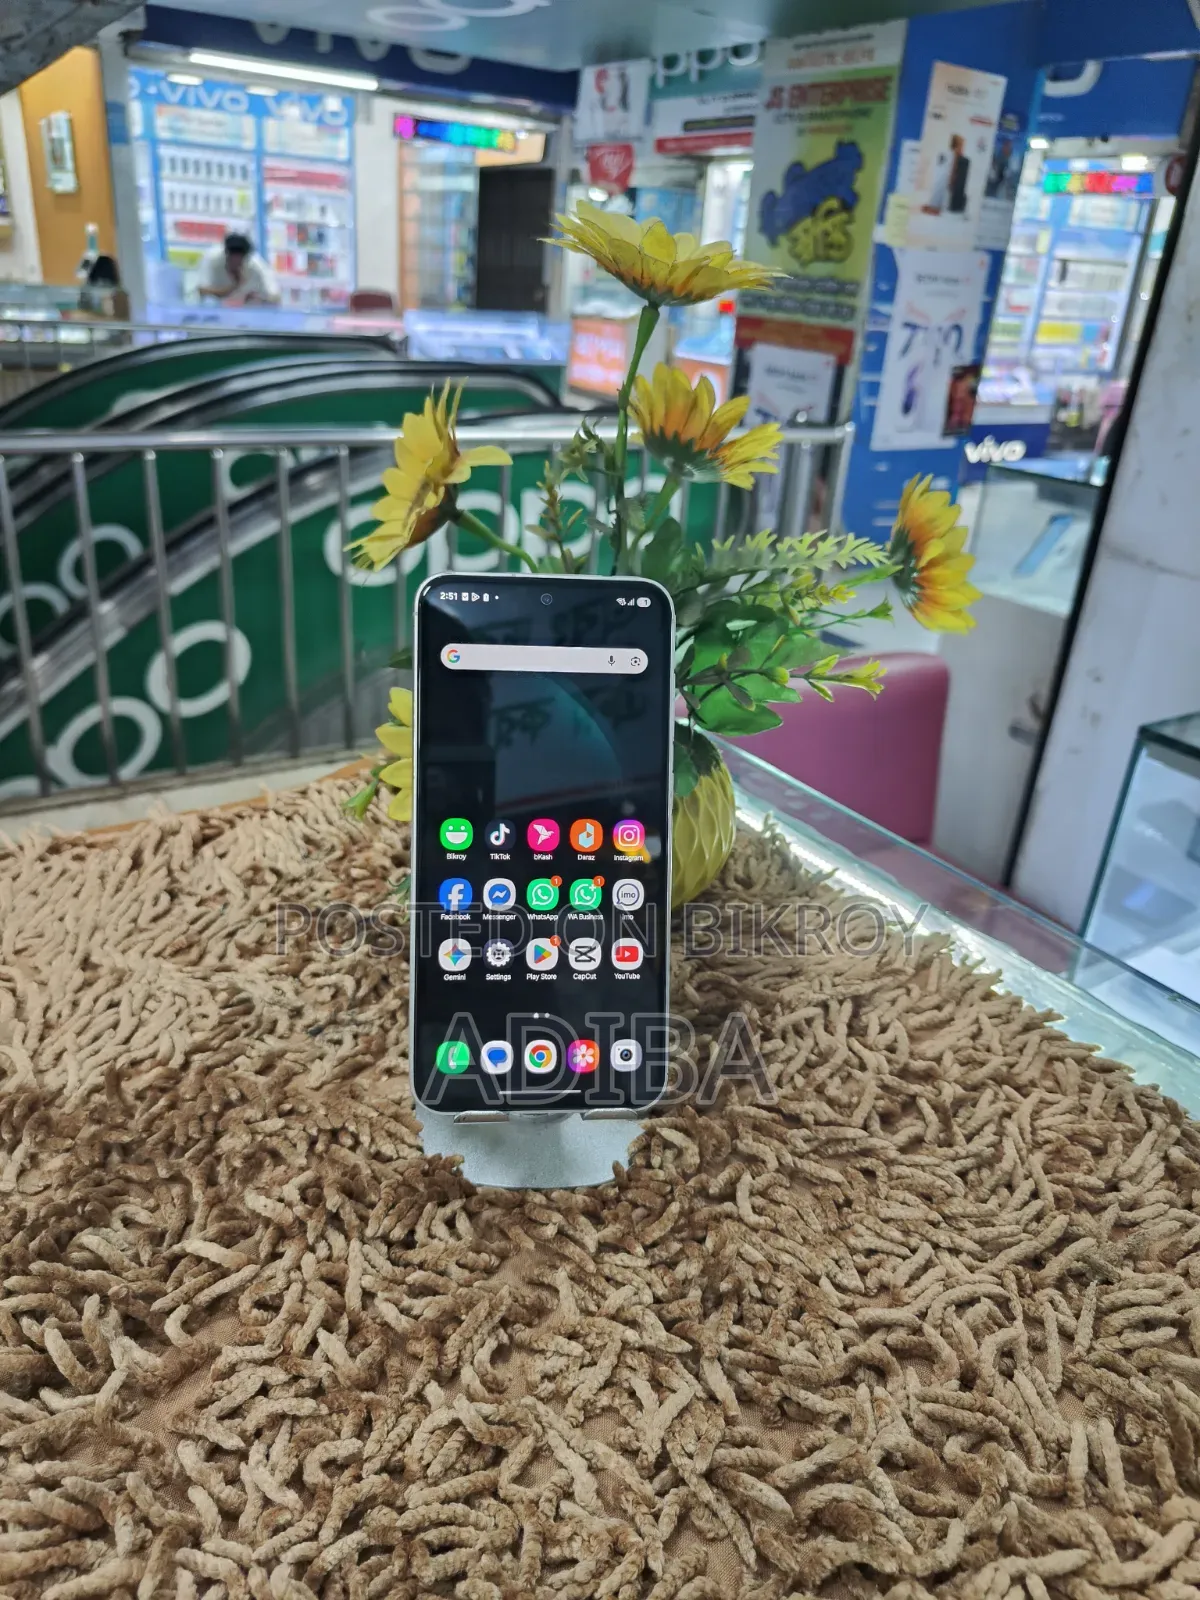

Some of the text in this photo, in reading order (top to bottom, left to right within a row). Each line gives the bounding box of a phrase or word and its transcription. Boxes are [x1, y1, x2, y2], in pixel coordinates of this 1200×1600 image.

[964, 435, 1027, 464] vivo
[440, 592, 458, 601] 2:51
[446, 853, 468, 862] Bikroy
[490, 853, 511, 861] TikTok
[613, 854, 644, 863] Instagram
[621, 890, 636, 899] imo
[440, 913, 471, 921] Facebook
[482, 913, 517, 922] Messenger
[527, 913, 559, 922] WhatsApp
[568, 913, 604, 921] WA Business
[443, 973, 467, 981] Gemini
[485, 973, 512, 982] Settings
[526, 973, 557, 982] Play Store
[572, 972, 597, 981] CapCut
[614, 972, 641, 981] YouTube
